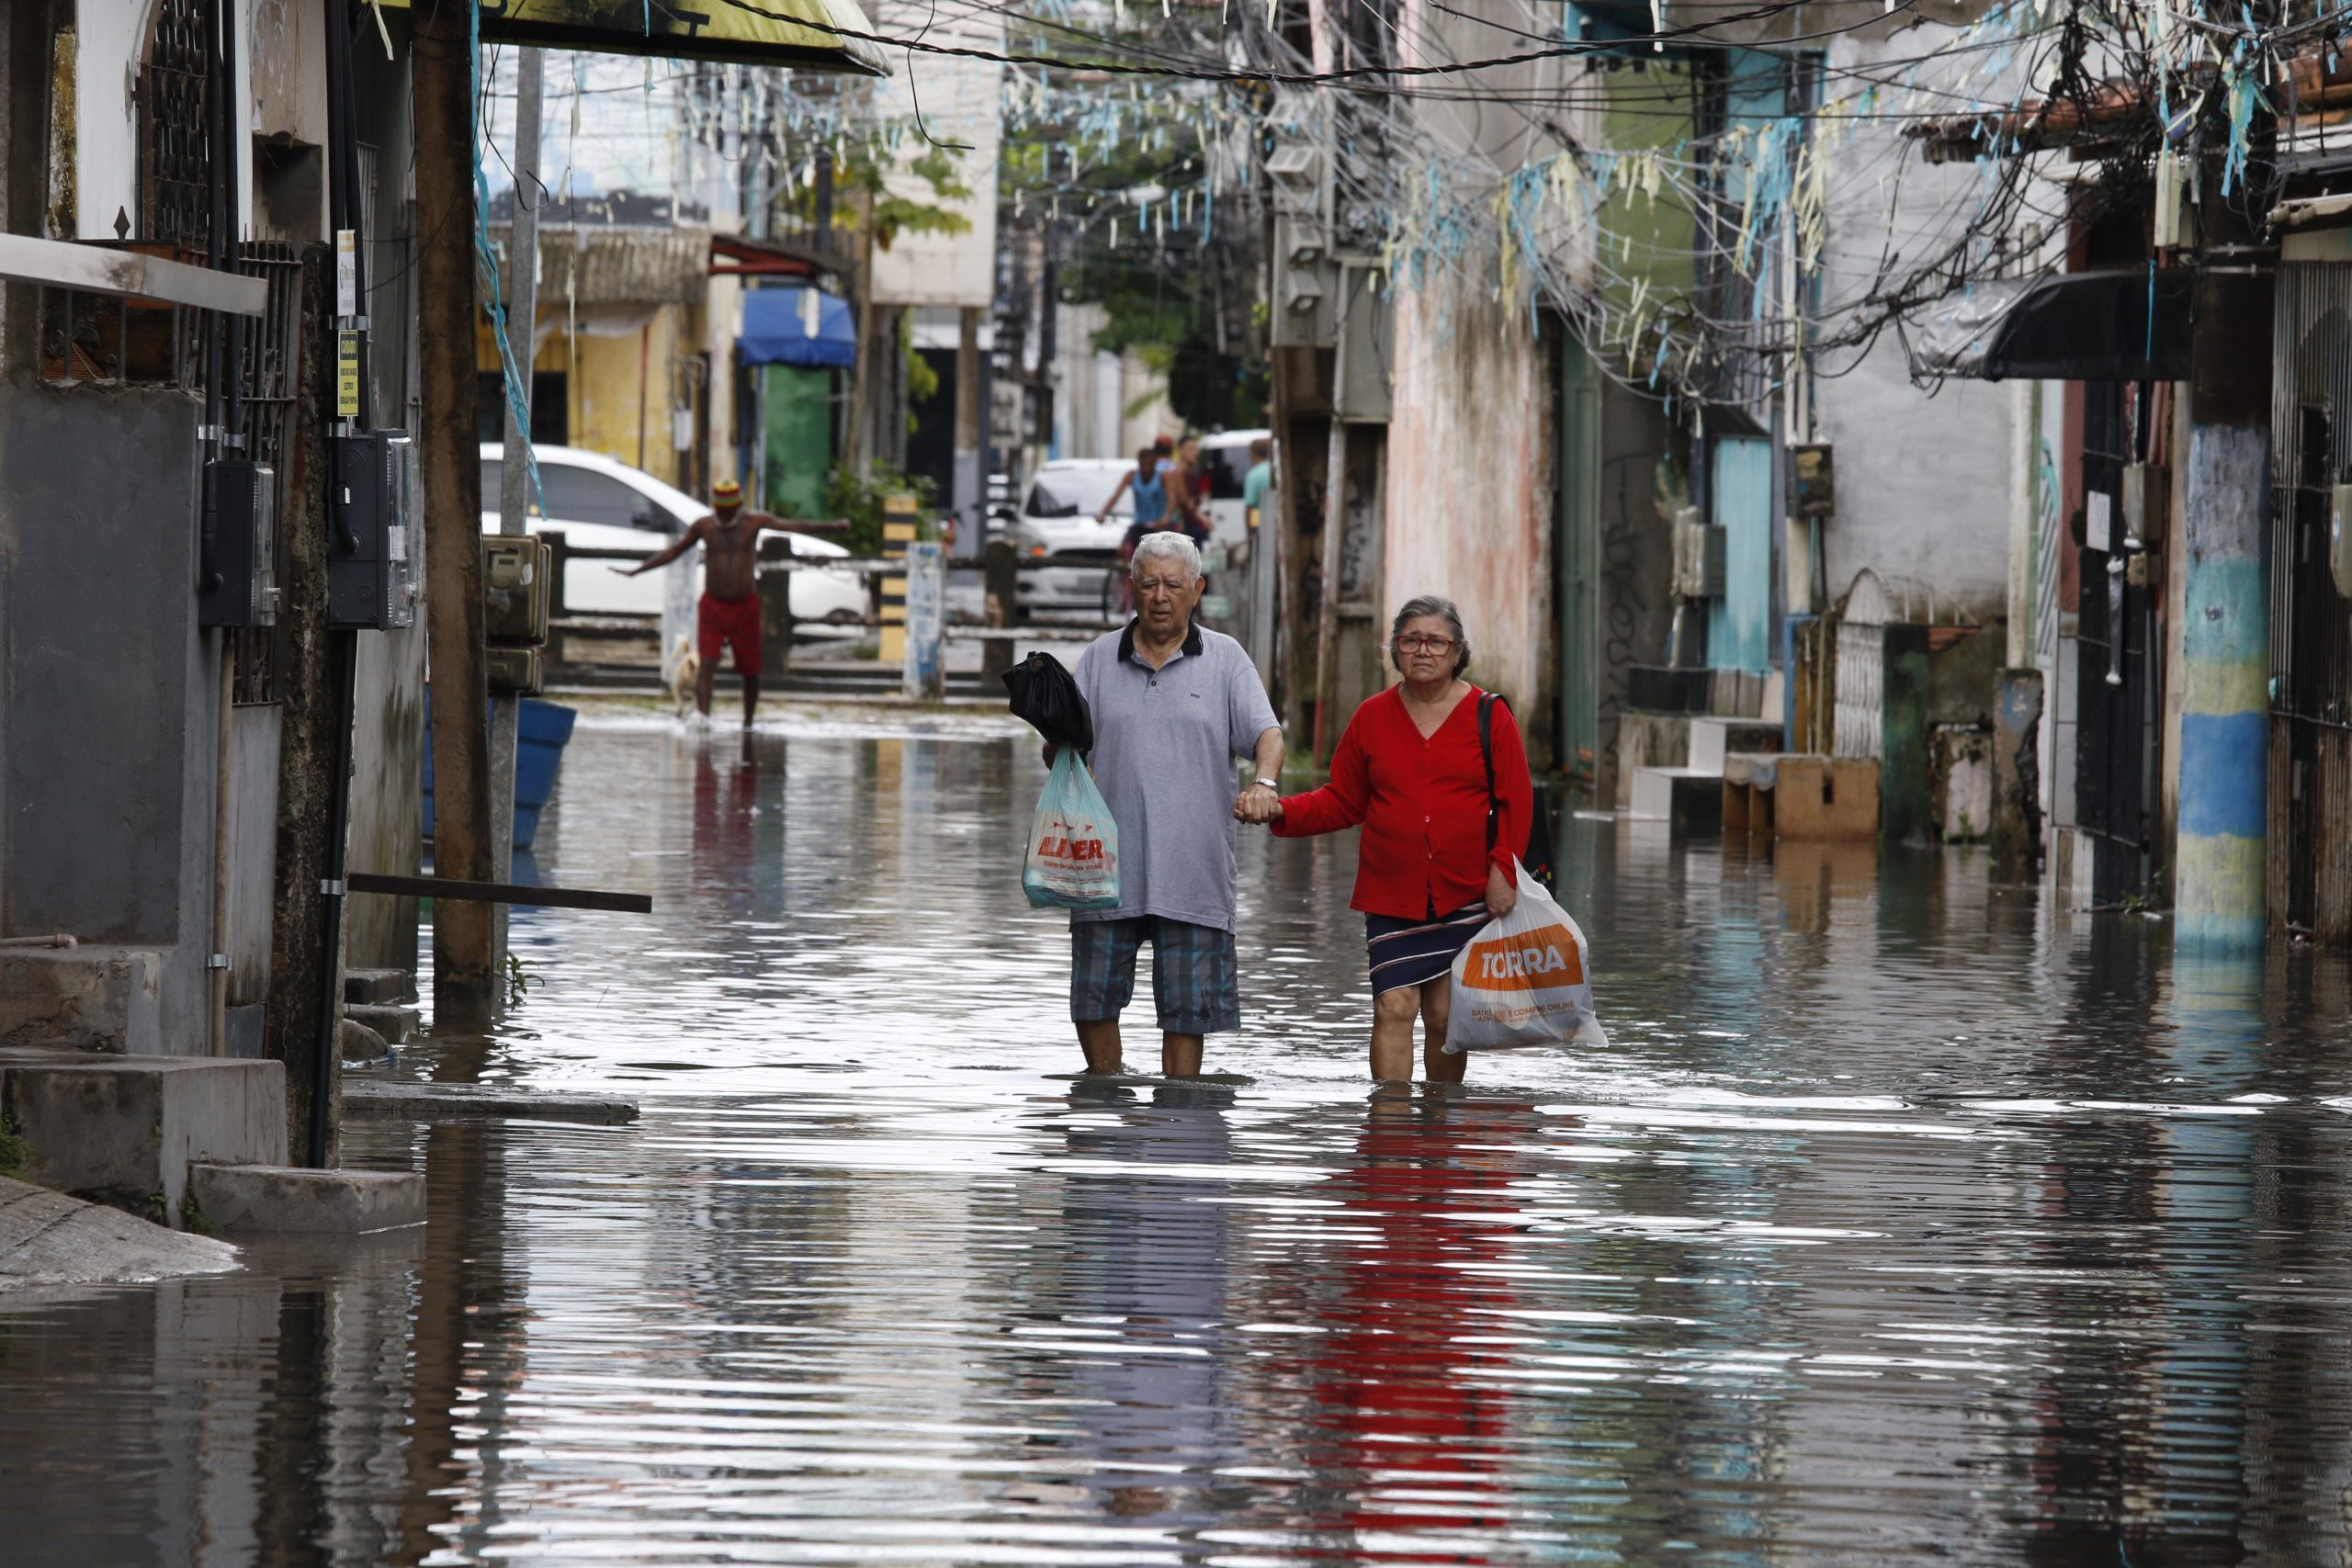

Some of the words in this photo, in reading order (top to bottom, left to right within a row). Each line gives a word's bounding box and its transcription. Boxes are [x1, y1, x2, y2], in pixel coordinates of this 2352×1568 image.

[1038, 837, 1103, 861] LIER
[1481, 944, 1566, 979] TORRA
[1547, 1000, 1575, 1011] ONLINE
